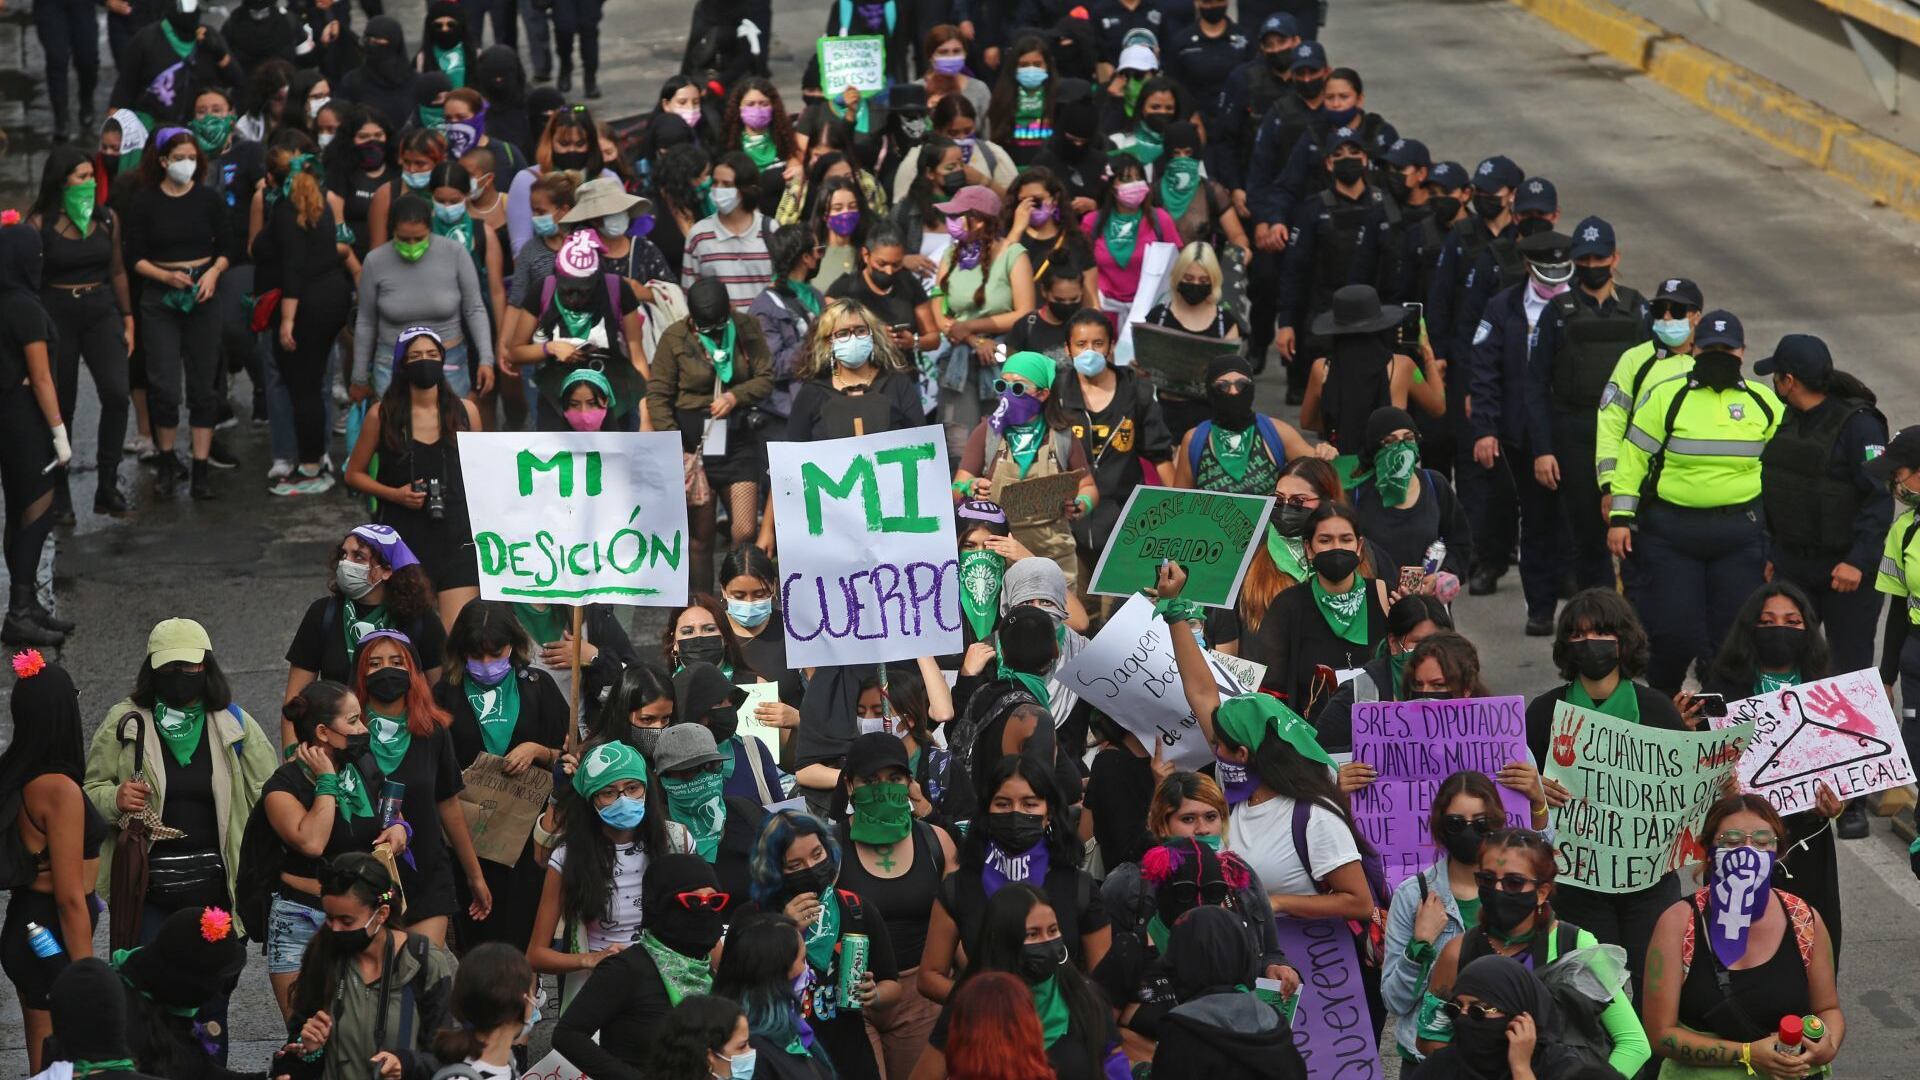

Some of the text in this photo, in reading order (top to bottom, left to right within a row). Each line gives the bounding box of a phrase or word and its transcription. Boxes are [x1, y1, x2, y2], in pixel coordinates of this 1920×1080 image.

[516, 449, 602, 497] MI
[801, 442, 940, 536] MI
[474, 505, 682, 587] DESICIÓN
[1121, 492, 1185, 545] SOBRE
[1187, 493, 1218, 516] MI
[1211, 498, 1257, 553] CUERPO
[1138, 536, 1223, 564] DECIDO
[782, 560, 961, 641] CUERPO
[1076, 629, 1160, 698] Saquen
[1156, 724, 1182, 747] de
[1356, 701, 1524, 740] SRES. DIPUTADOS
[1582, 723, 1745, 778] ¿CUÁNTAS MÁS
[1578, 766, 1686, 813] TENDRÁN
[1833, 757, 1911, 797] LEGAL!
[1554, 799, 1624, 848] MORIR
[1558, 841, 1601, 888] SEA
